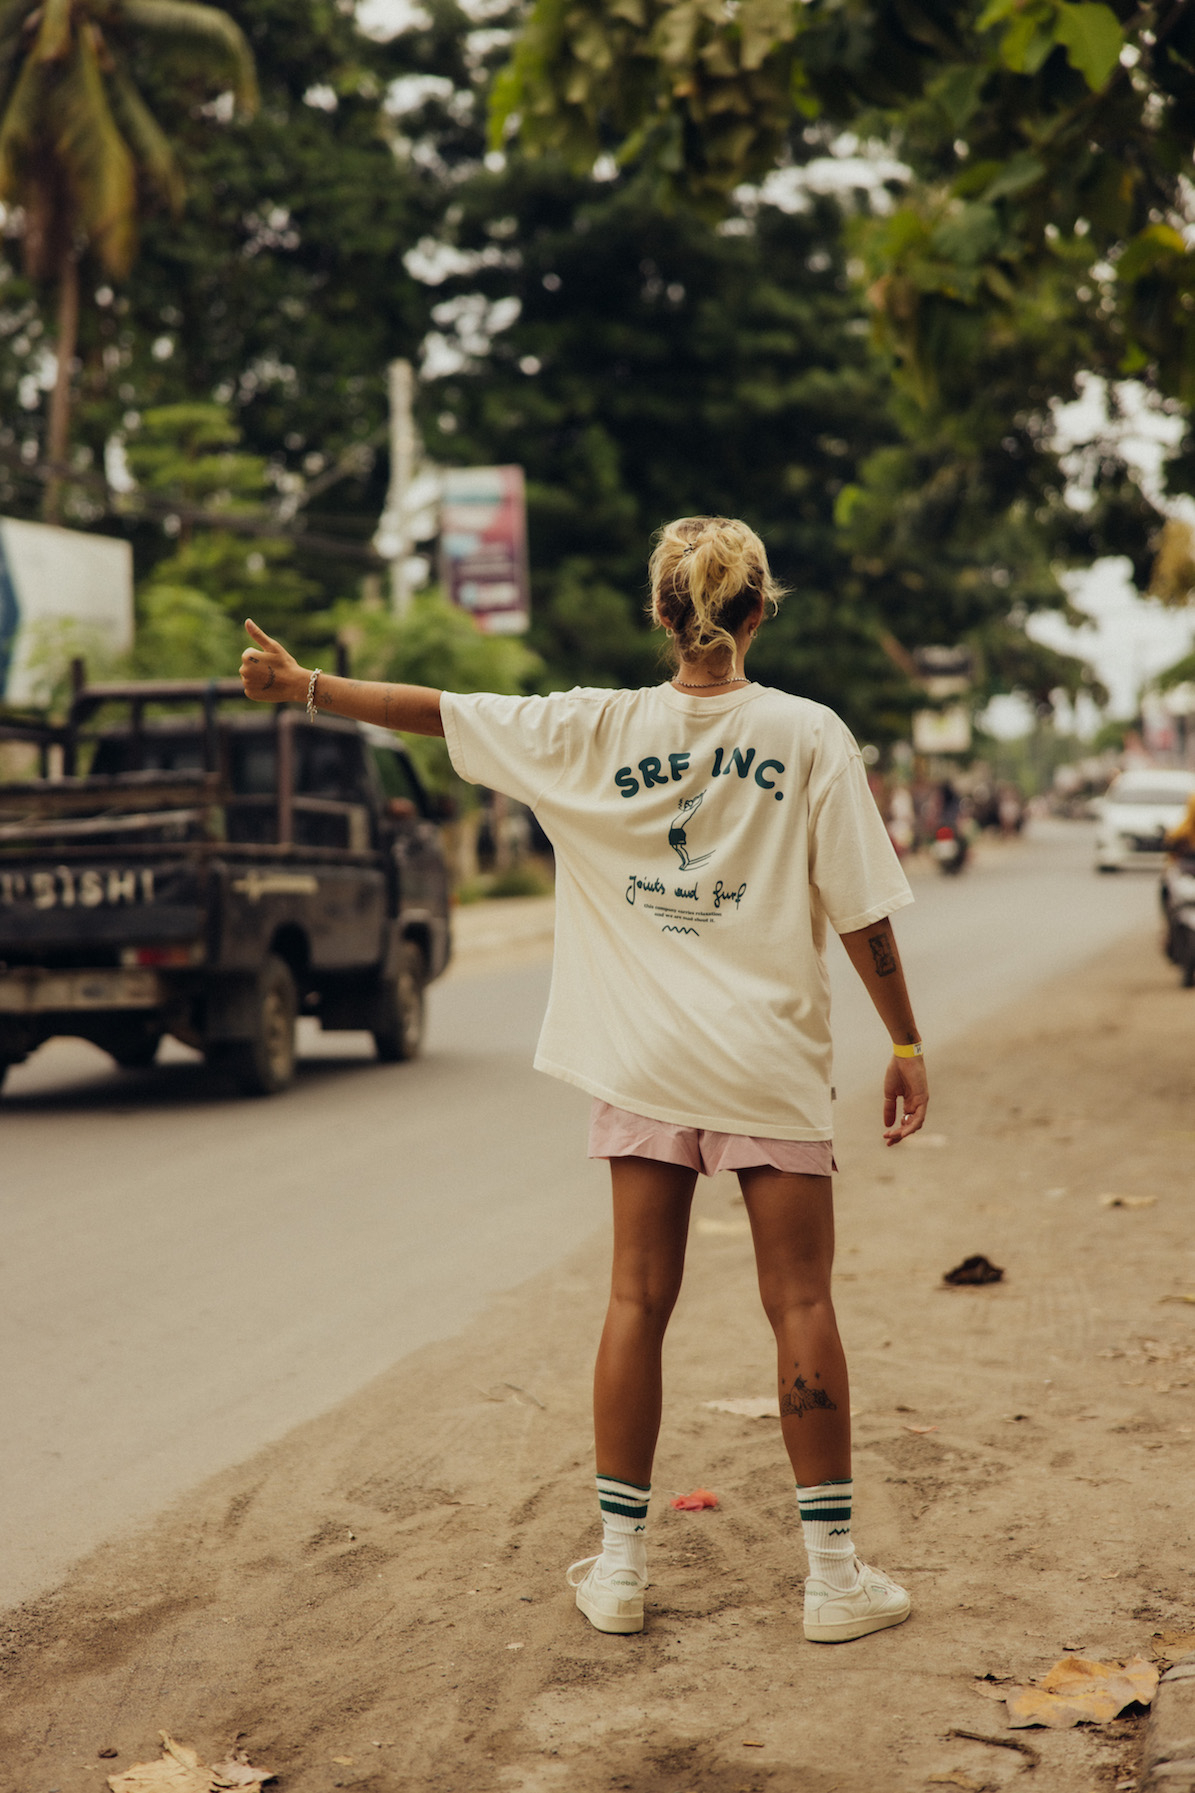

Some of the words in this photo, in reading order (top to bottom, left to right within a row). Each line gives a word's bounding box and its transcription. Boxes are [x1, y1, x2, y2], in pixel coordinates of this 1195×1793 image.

[614, 752, 691, 798] SRF
[711, 747, 786, 801] INC.
[626, 875, 666, 905] Joints
[674, 882, 699, 901] and
